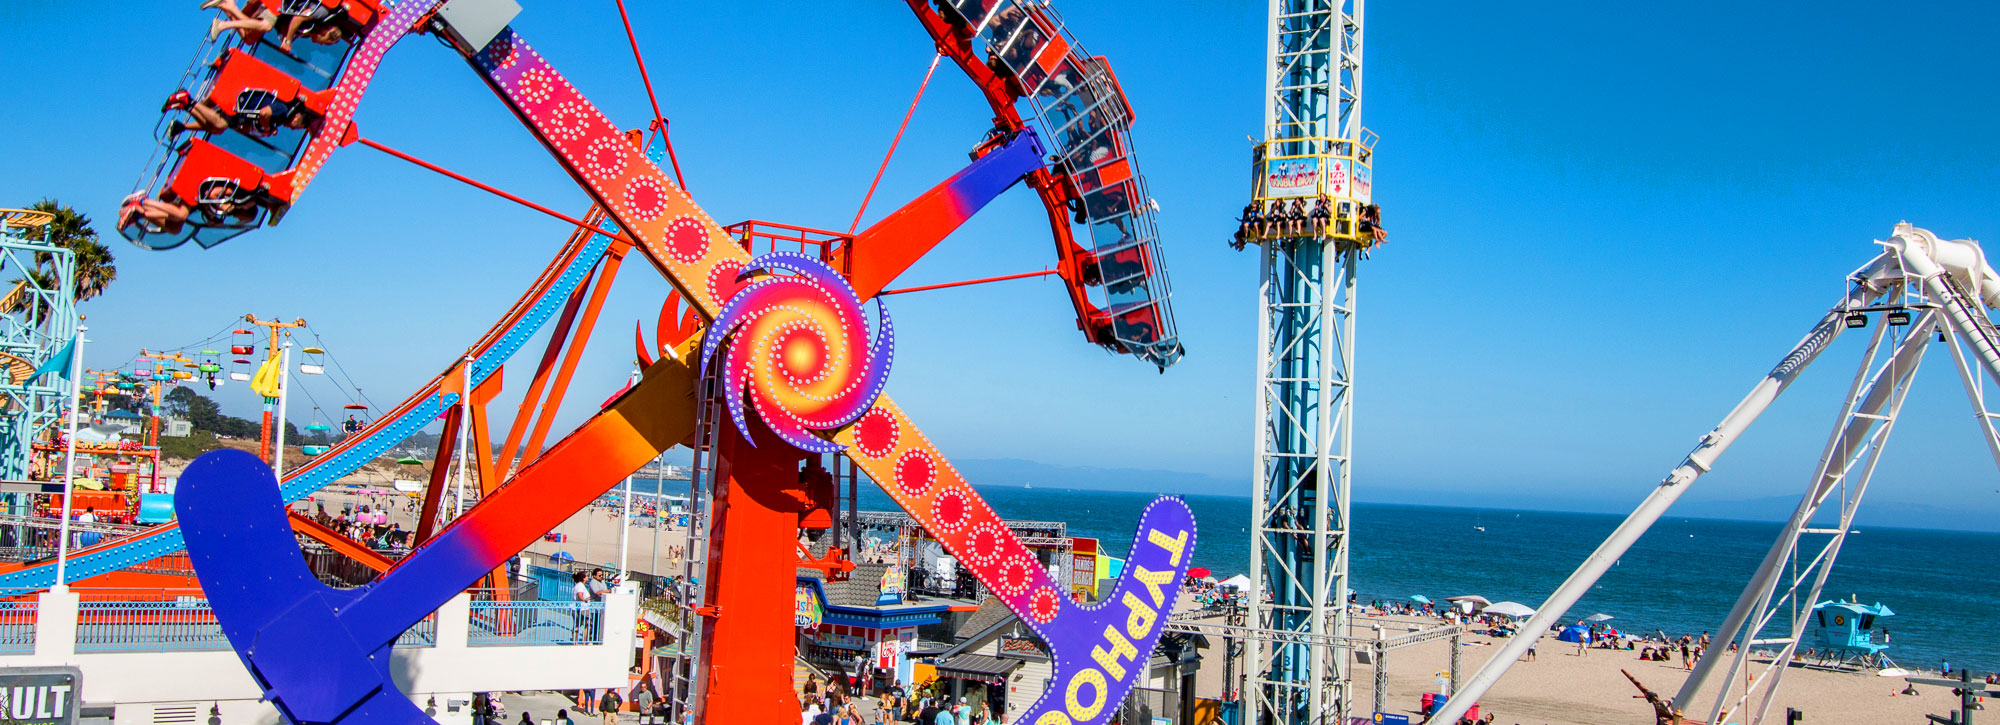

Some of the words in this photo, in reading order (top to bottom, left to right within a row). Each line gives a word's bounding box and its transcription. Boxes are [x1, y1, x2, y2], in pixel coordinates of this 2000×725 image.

[1330, 171, 1345, 179] 125
[1074, 571, 1094, 585] BEACH
[1003, 638, 1037, 651] BEACH
[1284, 655, 1291, 667] 3
